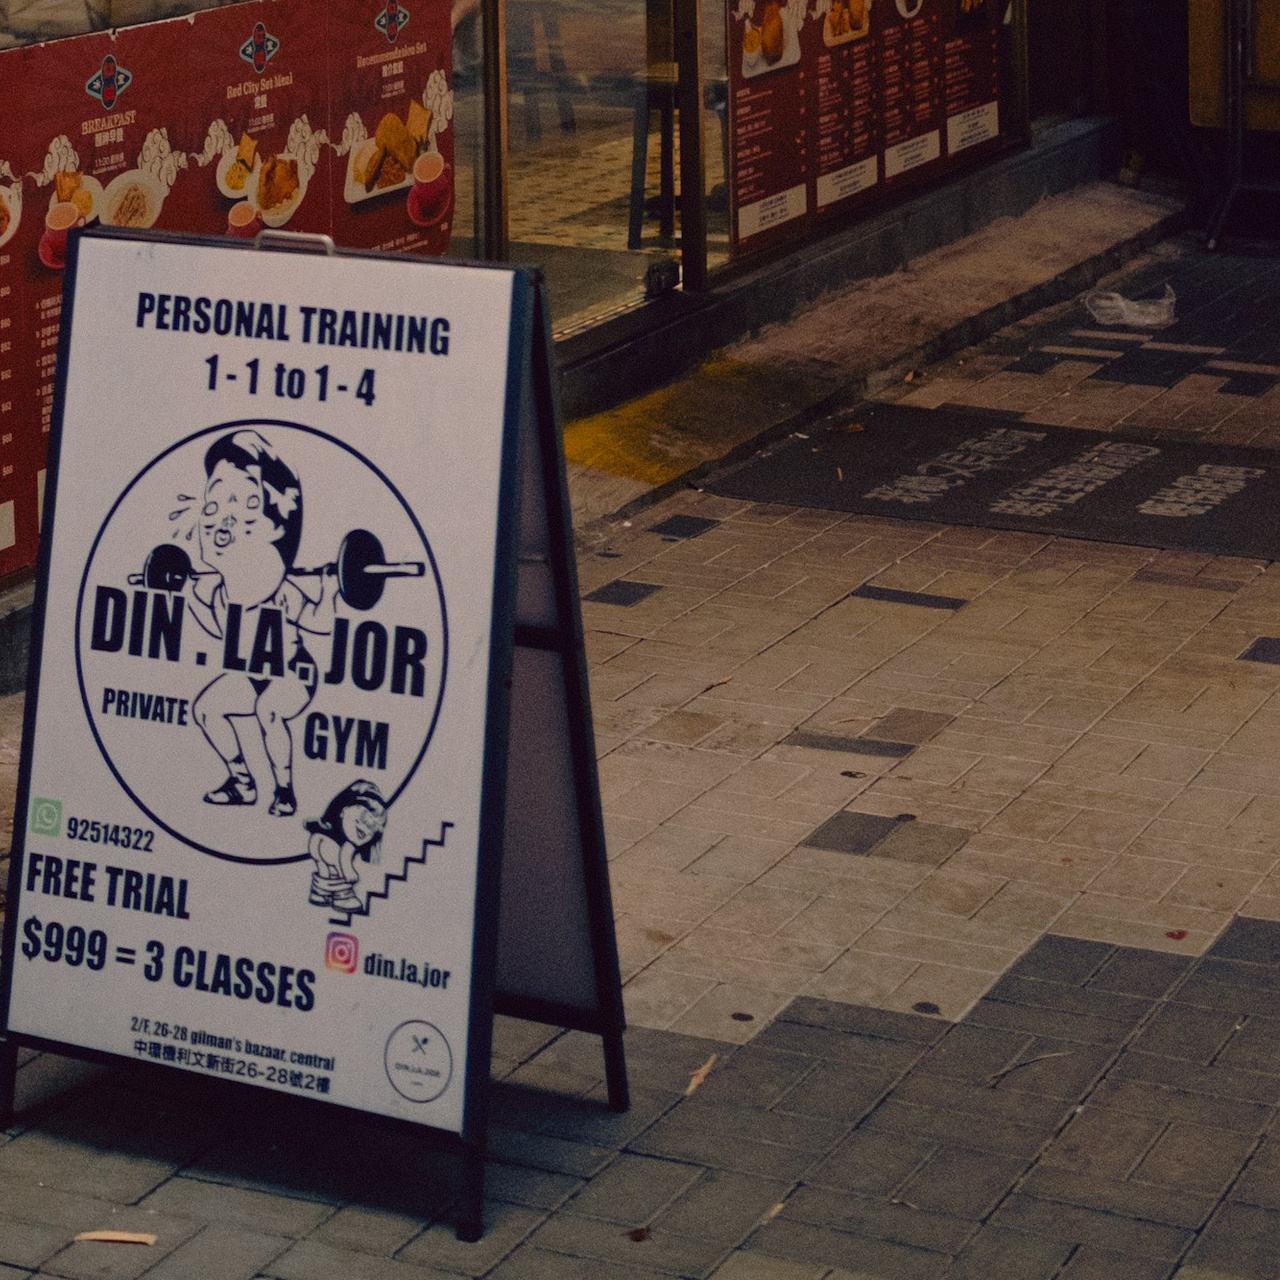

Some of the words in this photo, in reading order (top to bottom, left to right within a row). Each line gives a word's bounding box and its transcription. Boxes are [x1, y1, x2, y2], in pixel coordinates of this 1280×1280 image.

[226, 83, 243, 99] Red
[243, 81, 260, 96] City
[260, 77, 274, 91] Set
[274, 71, 293, 88] Meal
[81, 109, 137, 136] BREAKFAST
[136, 291, 288, 343] PERSONAL
[299, 305, 452, 357] TRAINING
[273, 362, 306, 400] to
[102, 687, 190, 727] PRIVATE
[303, 710, 391, 771] GYM
[66, 815, 156, 854] 92514322
[25, 851, 96, 904] FREE
[104, 865, 191, 921] TRIAL
[21, 914, 108, 973] $999
[143, 939, 165, 984] 3
[172, 950, 317, 1013] CLASSES
[363, 951, 452, 991] din.la.jor
[153, 1020, 189, 1042] 26-28
[190, 1027, 245, 1055] gilman's
[289, 1049, 336, 1072] central
